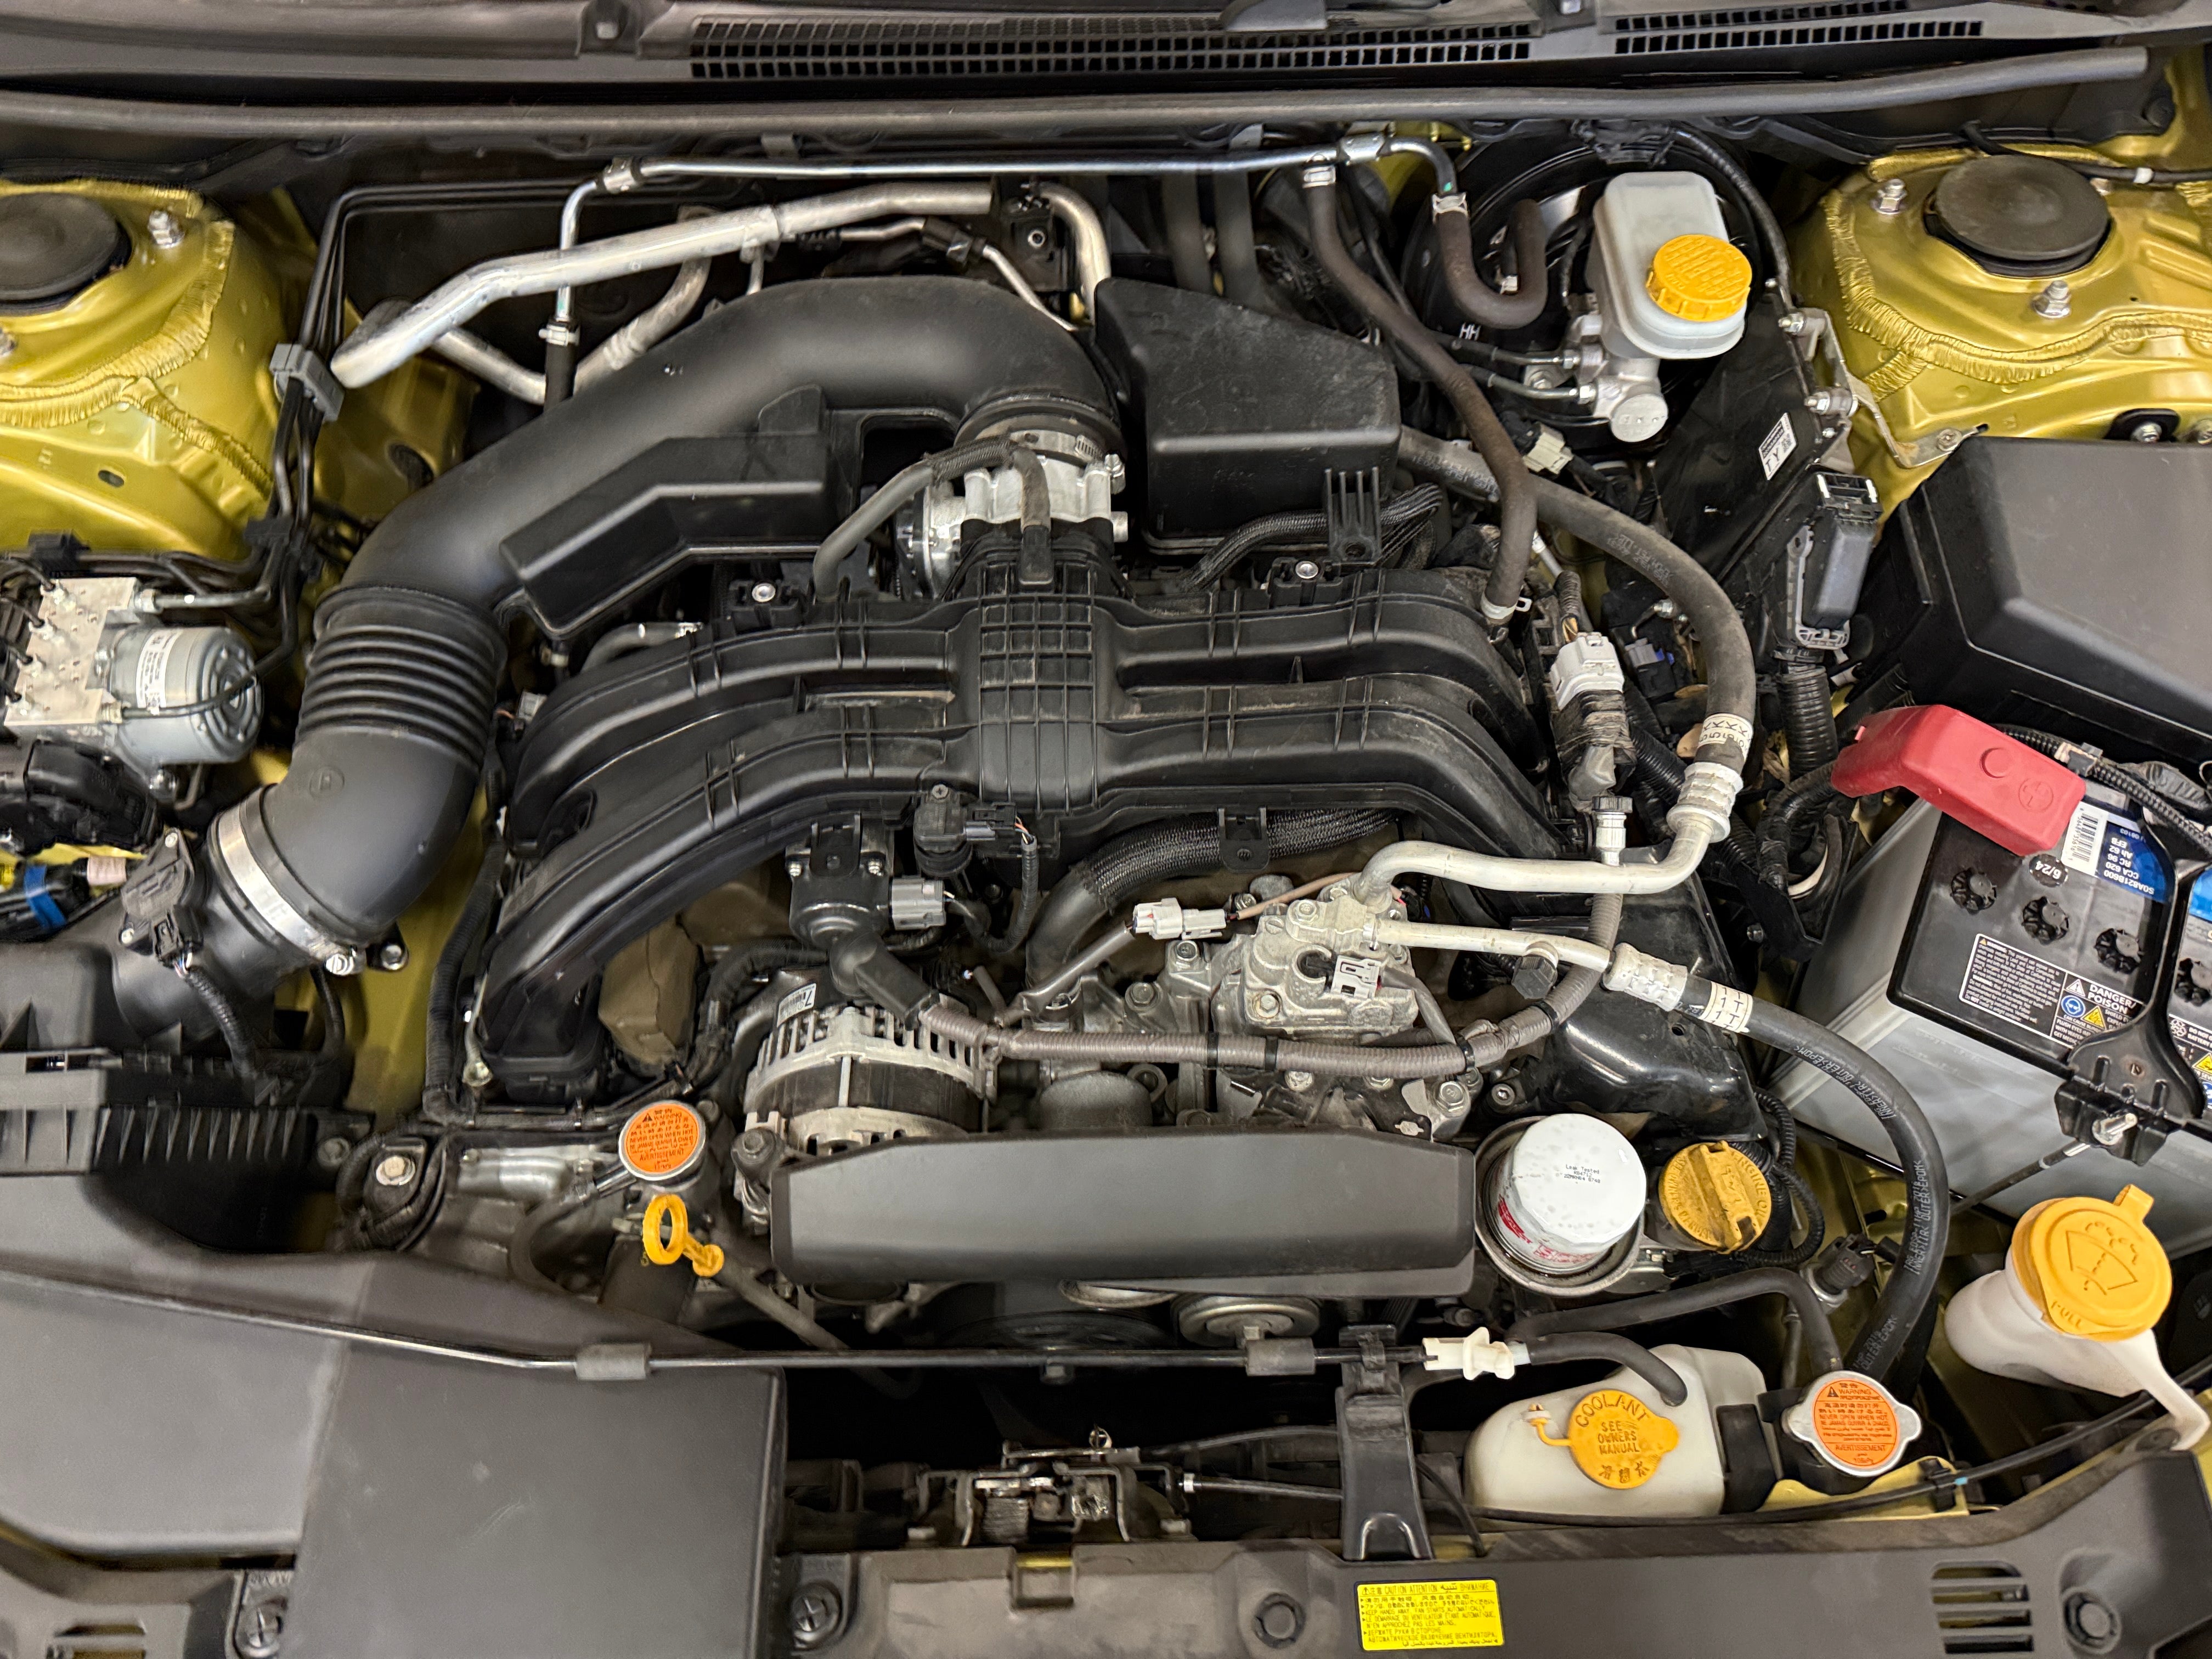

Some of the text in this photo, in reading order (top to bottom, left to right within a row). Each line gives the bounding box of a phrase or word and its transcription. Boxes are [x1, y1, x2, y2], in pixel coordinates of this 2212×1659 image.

[2110, 837, 2128, 848] EFB
[2108, 844, 2133, 859] Ah 62
[2106, 853, 2132, 867] RC 96
[2033, 860, 2062, 880] 6/24
[2104, 861, 2140, 879] CCA 620
[2086, 992, 2129, 1014] POISON
[2087, 983, 2137, 1009] DANGER/
[1576, 1392, 1650, 1427] COOLANT
[1601, 1420, 1622, 1432] SEE
[1598, 1429, 1637, 1444] OWNERS
[1599, 1441, 1640, 1456] MANUAL
[1384, 1585, 1406, 1594] CAUTION
[1409, 1584, 1437, 1593] ATTENTION
